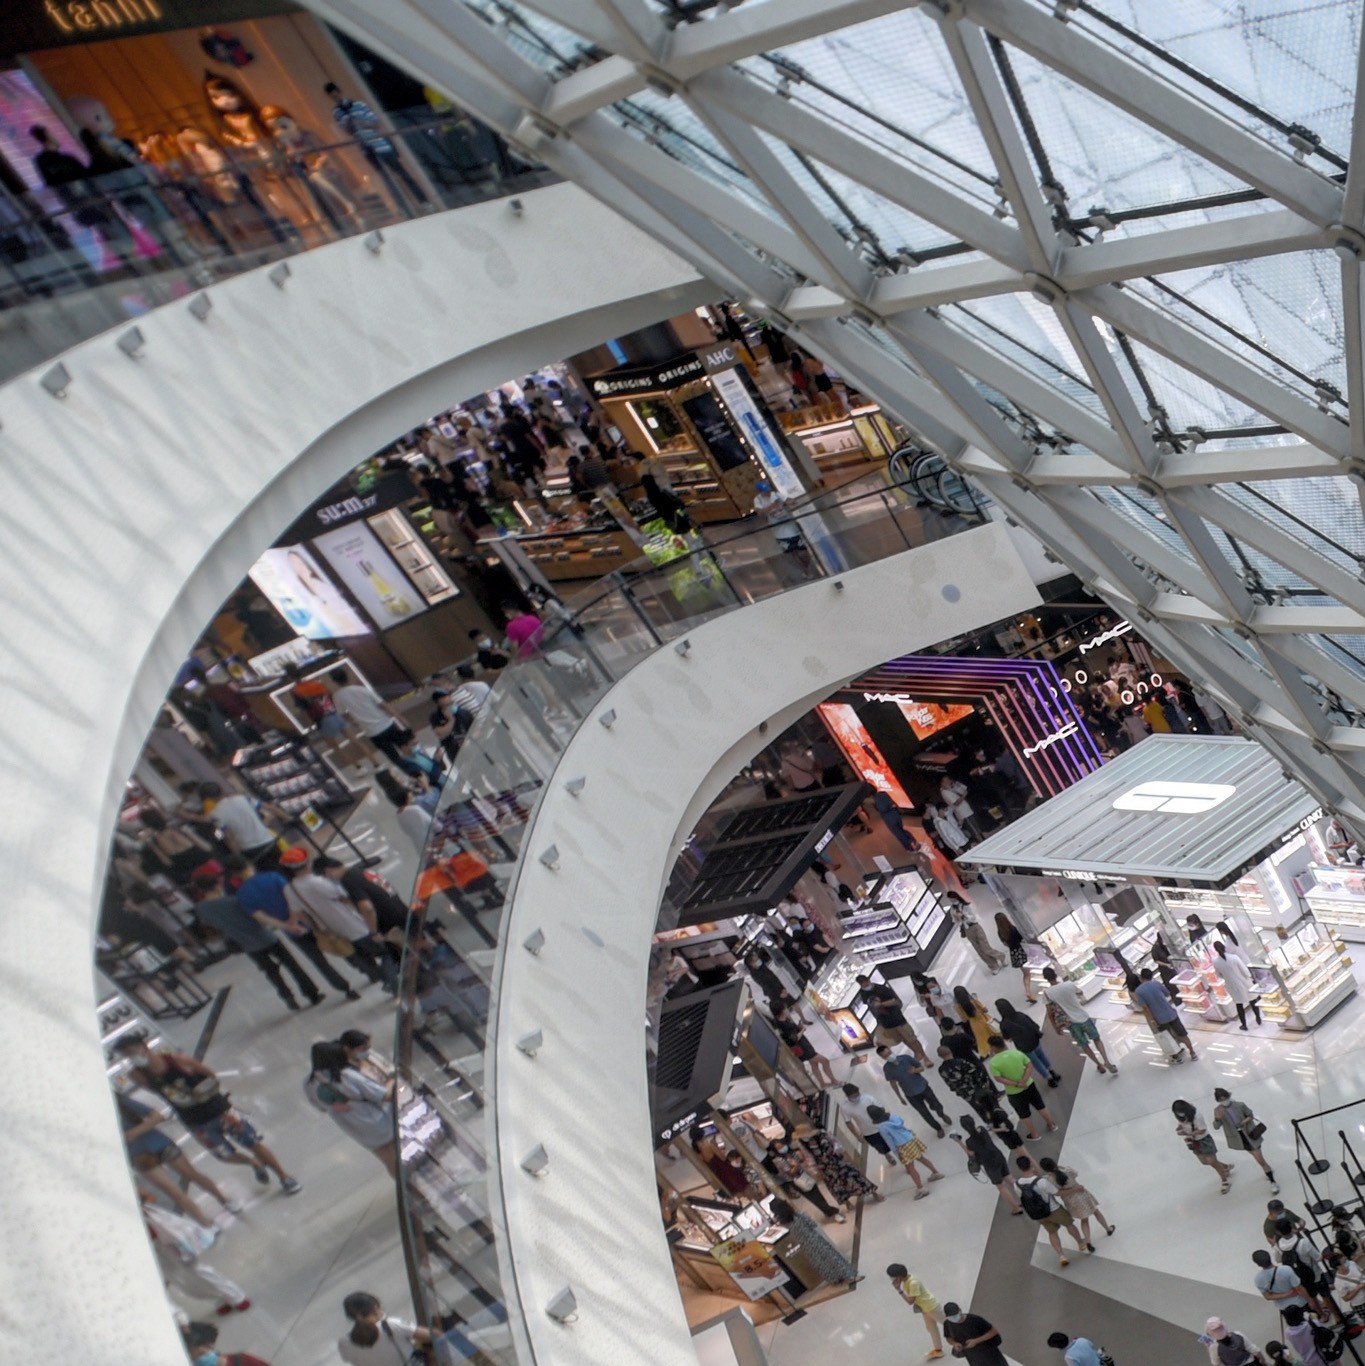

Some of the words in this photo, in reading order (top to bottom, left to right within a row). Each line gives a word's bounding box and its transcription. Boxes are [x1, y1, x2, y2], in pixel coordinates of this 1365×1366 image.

[706, 347, 735, 367] AHC
[658, 361, 702, 383] ORIGINS
[607, 377, 653, 393] ORIGINS
[1062, 870, 1098, 881] CLINIQUE
